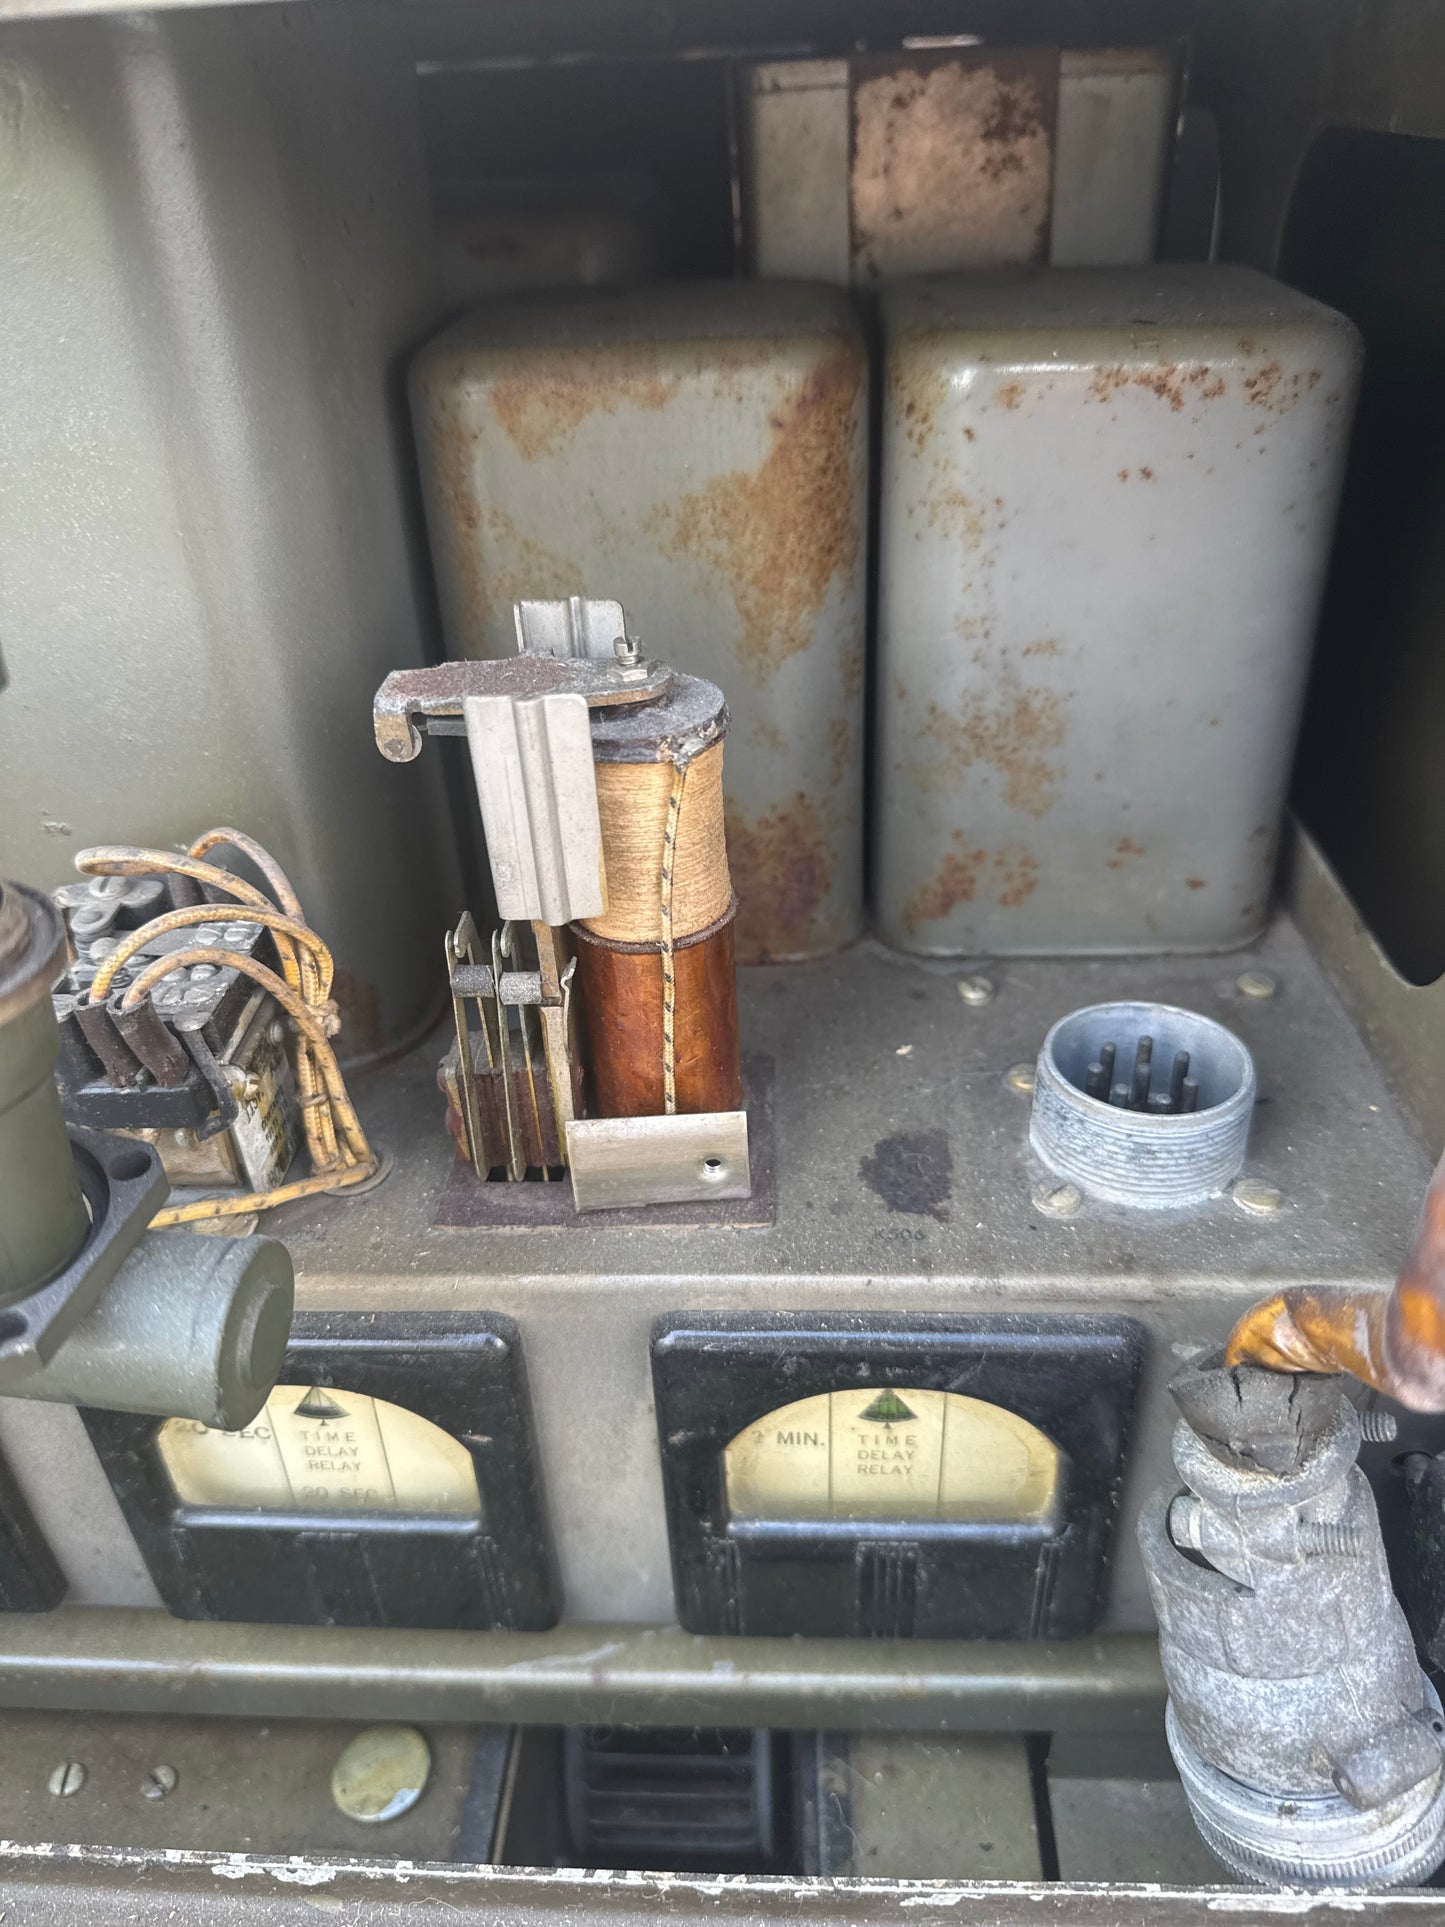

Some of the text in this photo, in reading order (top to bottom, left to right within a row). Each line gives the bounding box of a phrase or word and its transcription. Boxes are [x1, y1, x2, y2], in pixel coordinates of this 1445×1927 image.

[299, 1431, 357, 1442] TIME
[777, 1430, 824, 1446] MIN.
[857, 1434, 917, 1446] TIME
[305, 1446, 359, 1457] DELAY
[857, 1449, 914, 1460] DELAY
[308, 1460, 361, 1471] RELAY
[857, 1464, 913, 1475] RELAY
